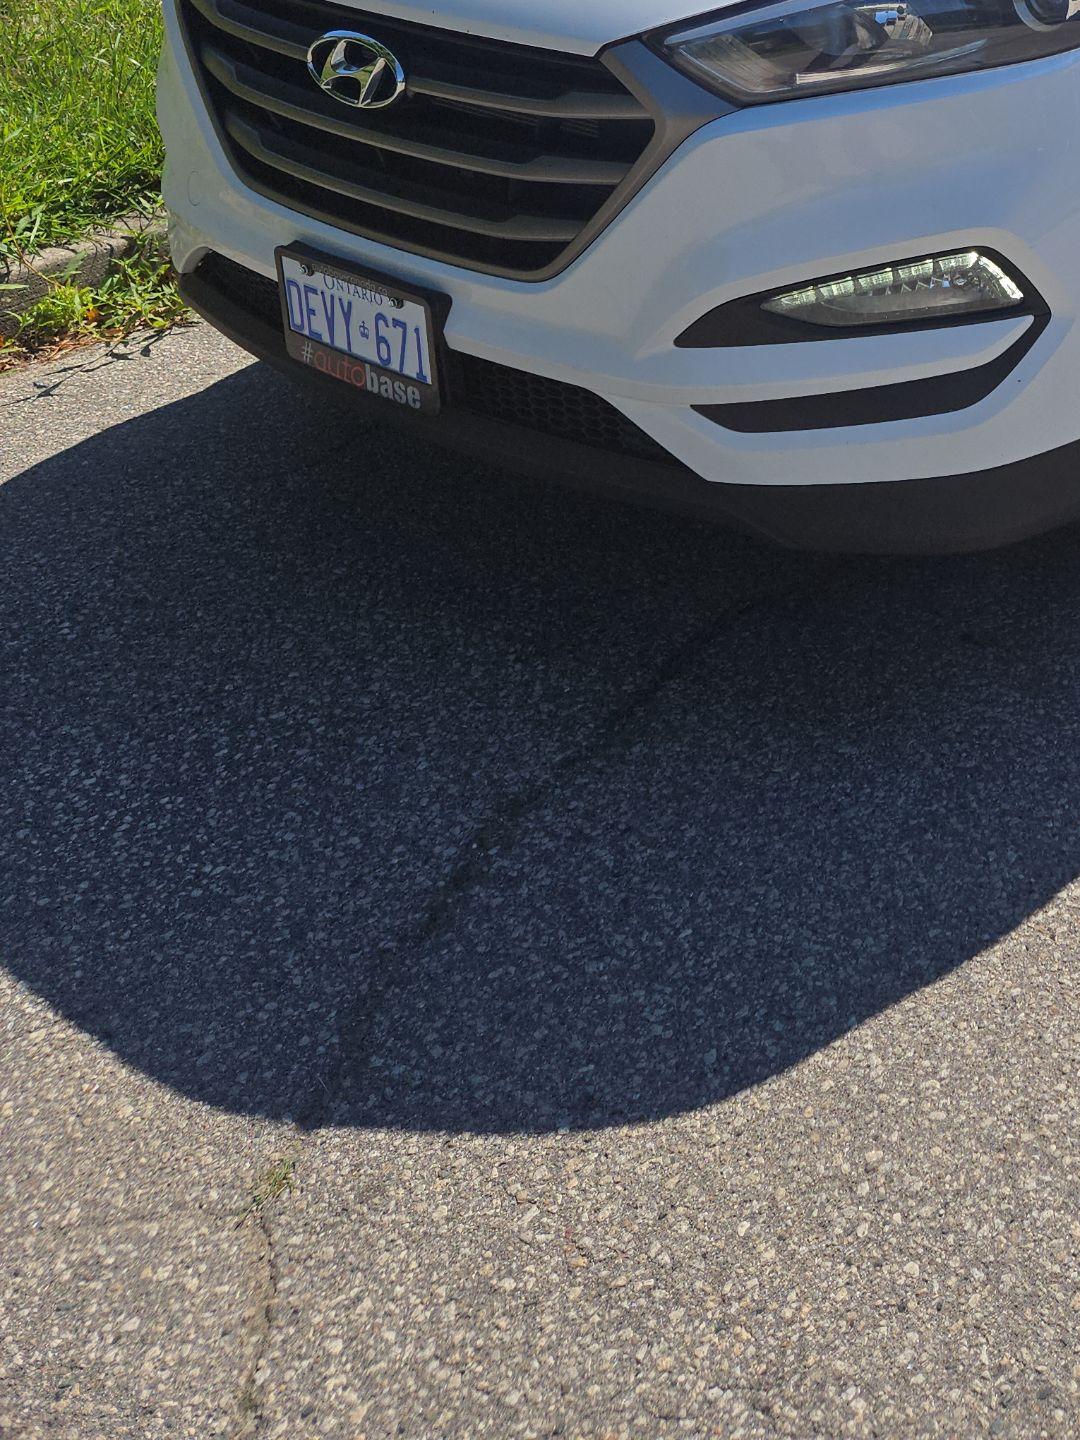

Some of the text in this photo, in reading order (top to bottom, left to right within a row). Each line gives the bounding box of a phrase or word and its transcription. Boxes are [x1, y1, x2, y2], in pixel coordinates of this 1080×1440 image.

[323, 273, 383, 306] ONTARIO
[286, 279, 428, 384] DEVY 671
[301, 341, 422, 410] #autobase
